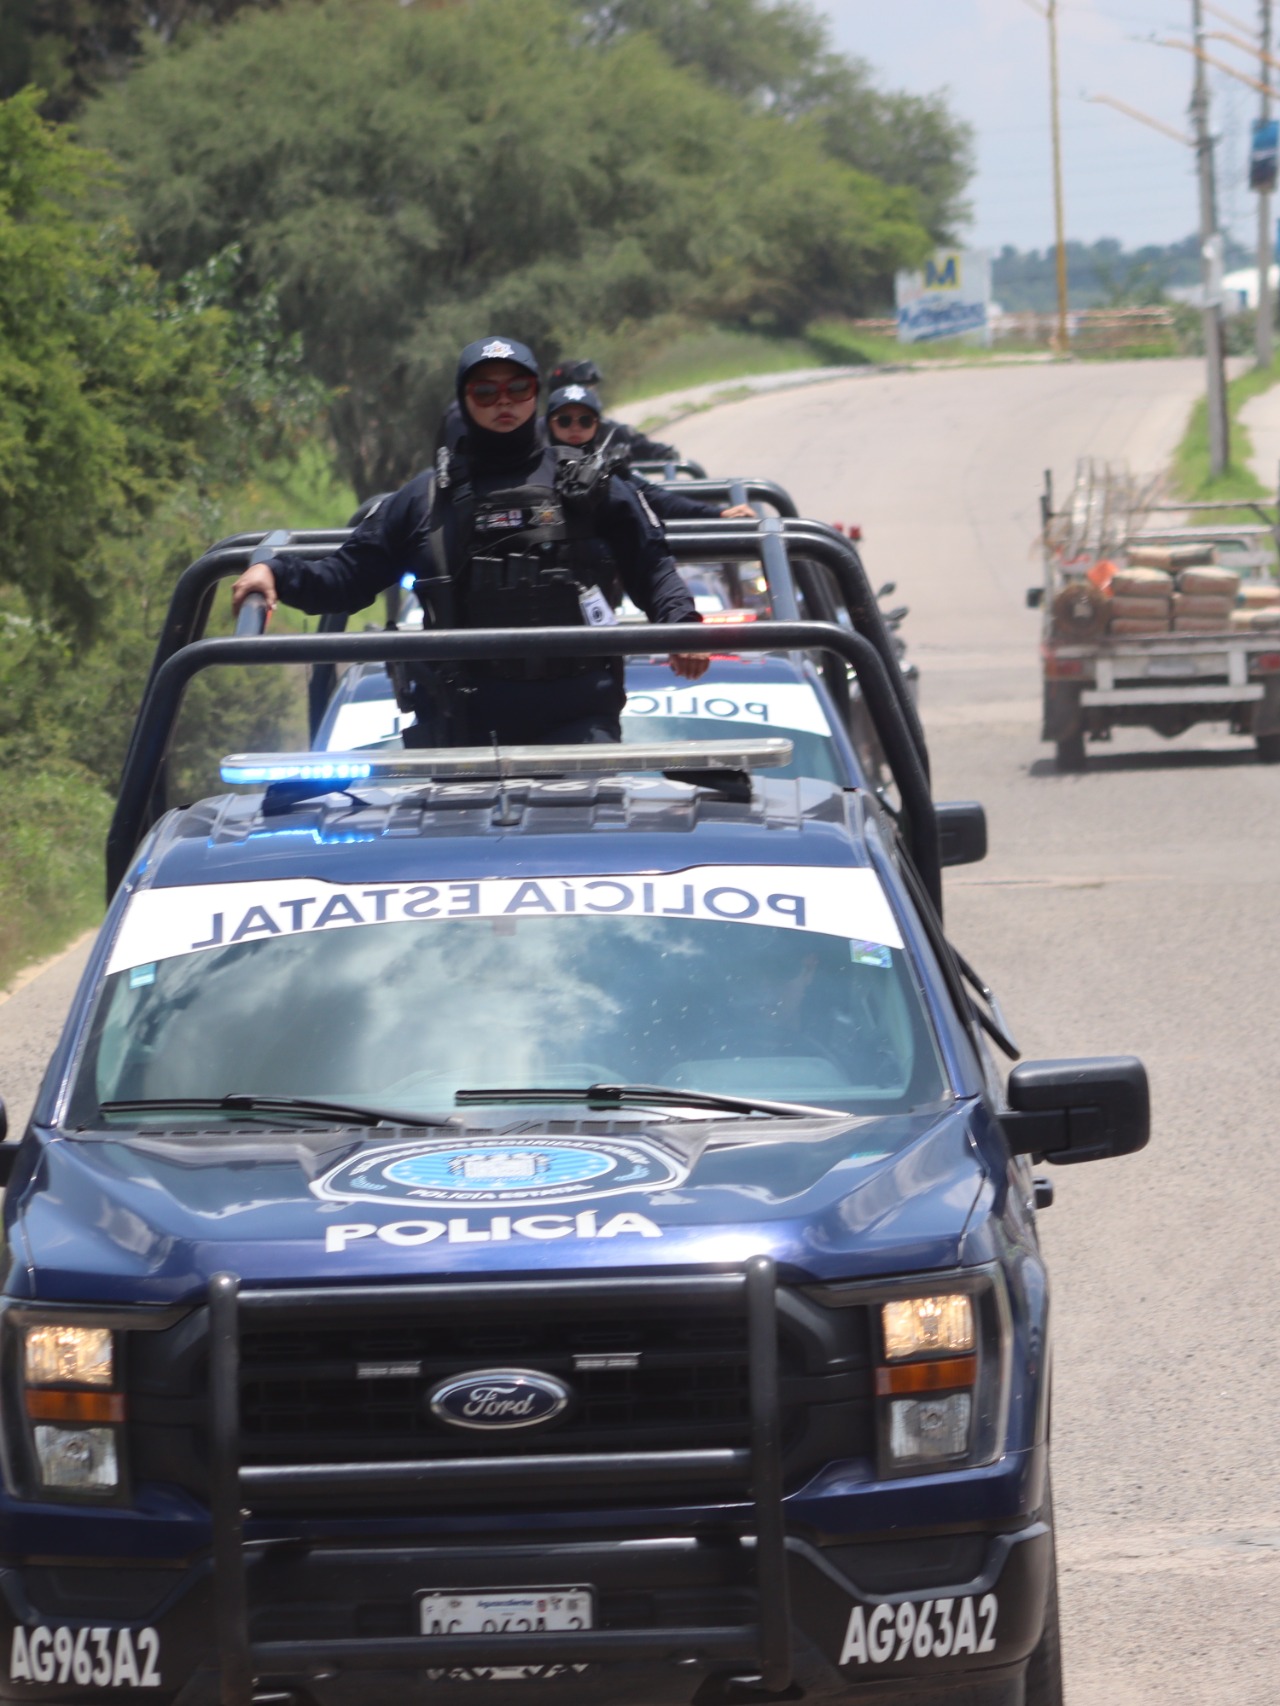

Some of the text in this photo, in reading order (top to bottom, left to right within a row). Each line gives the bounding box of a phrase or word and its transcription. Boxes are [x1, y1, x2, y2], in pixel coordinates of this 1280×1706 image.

[325, 1210, 663, 1252] POLICÍA
[463, 1386, 536, 1416] Ford
[838, 1593, 998, 1665] AG963A2
[10, 1626, 161, 1686] AG963A2
